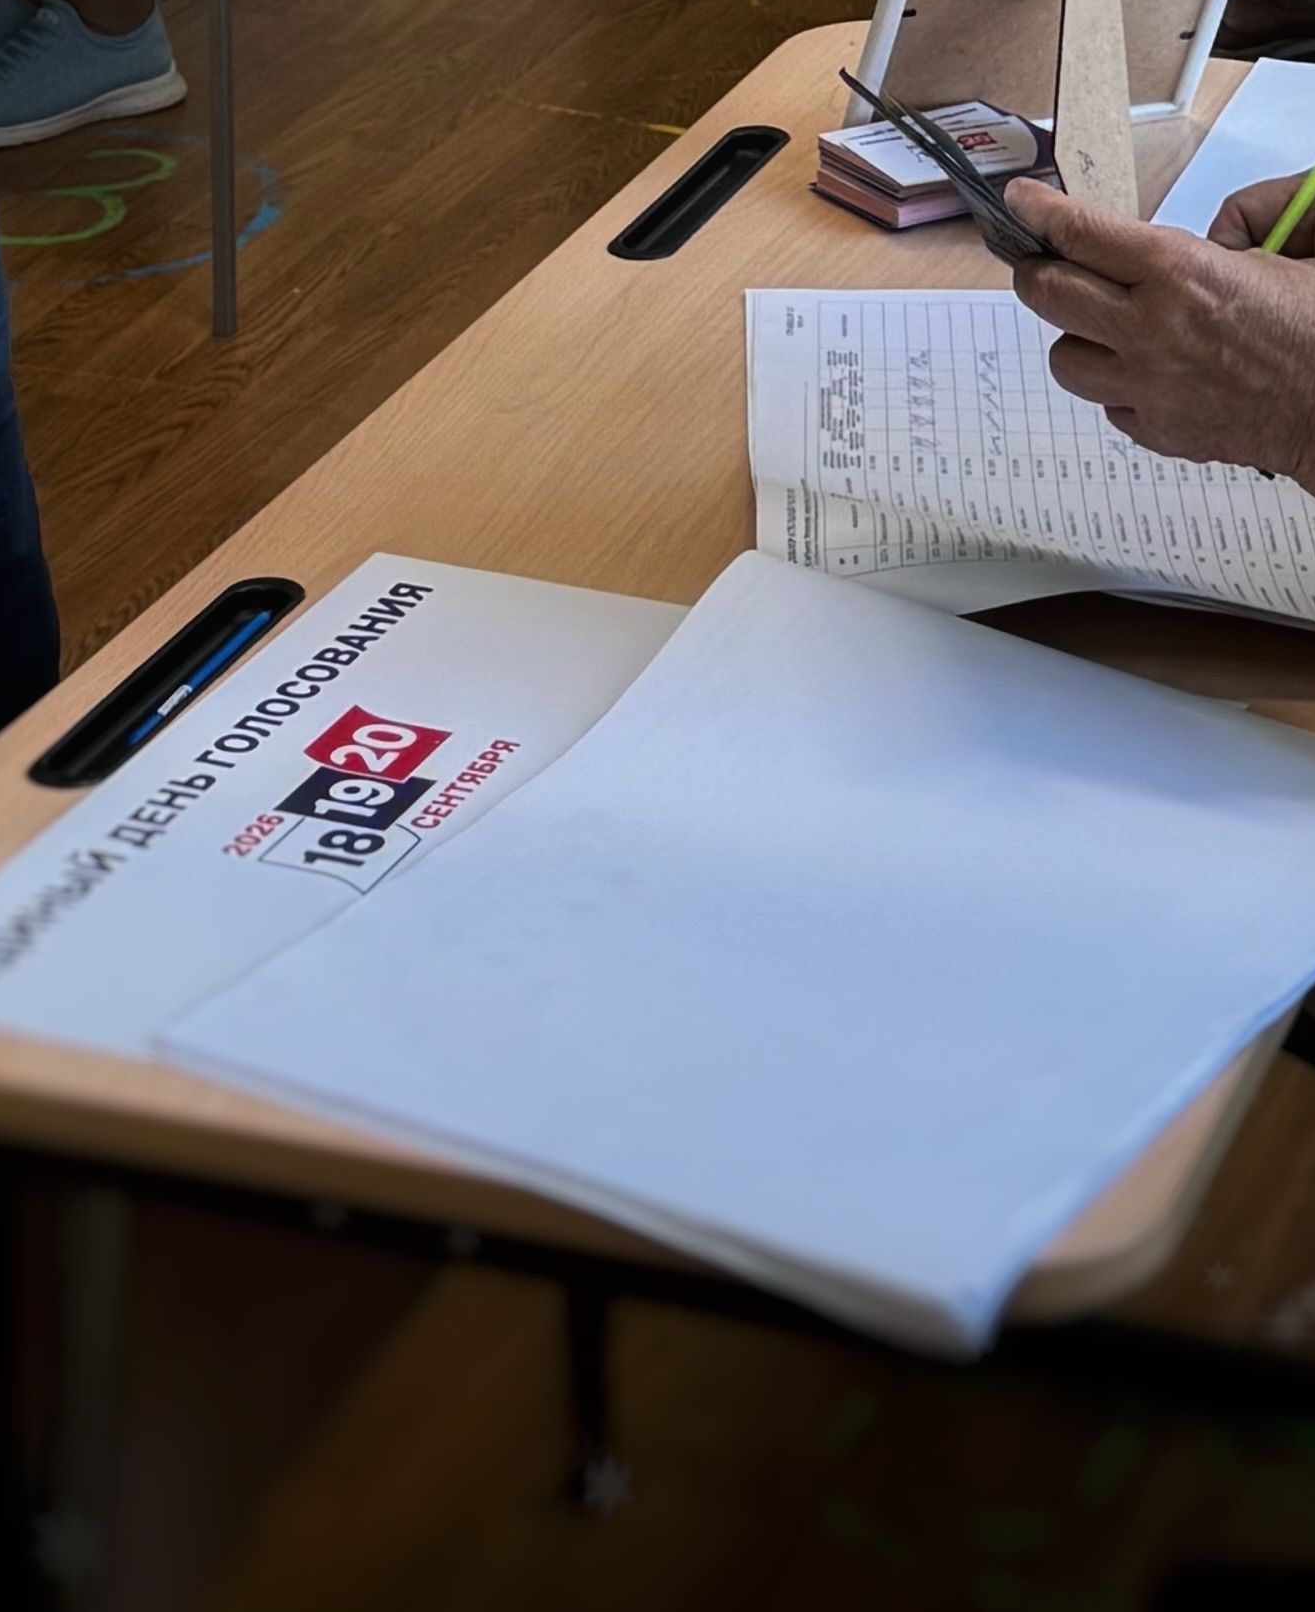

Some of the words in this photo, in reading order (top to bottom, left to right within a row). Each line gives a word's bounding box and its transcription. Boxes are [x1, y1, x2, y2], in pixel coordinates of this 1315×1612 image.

[107, 773, 217, 849] ДЕНЬ
[194, 581, 434, 769] ГОЛОСОВАНИЯ
[329, 723, 418, 773] 20
[313, 778, 395, 818] 19
[409, 739, 522, 830] СЕНТЯБРЯ
[221, 813, 285, 859] 2026
[303, 829, 386, 868] 18
